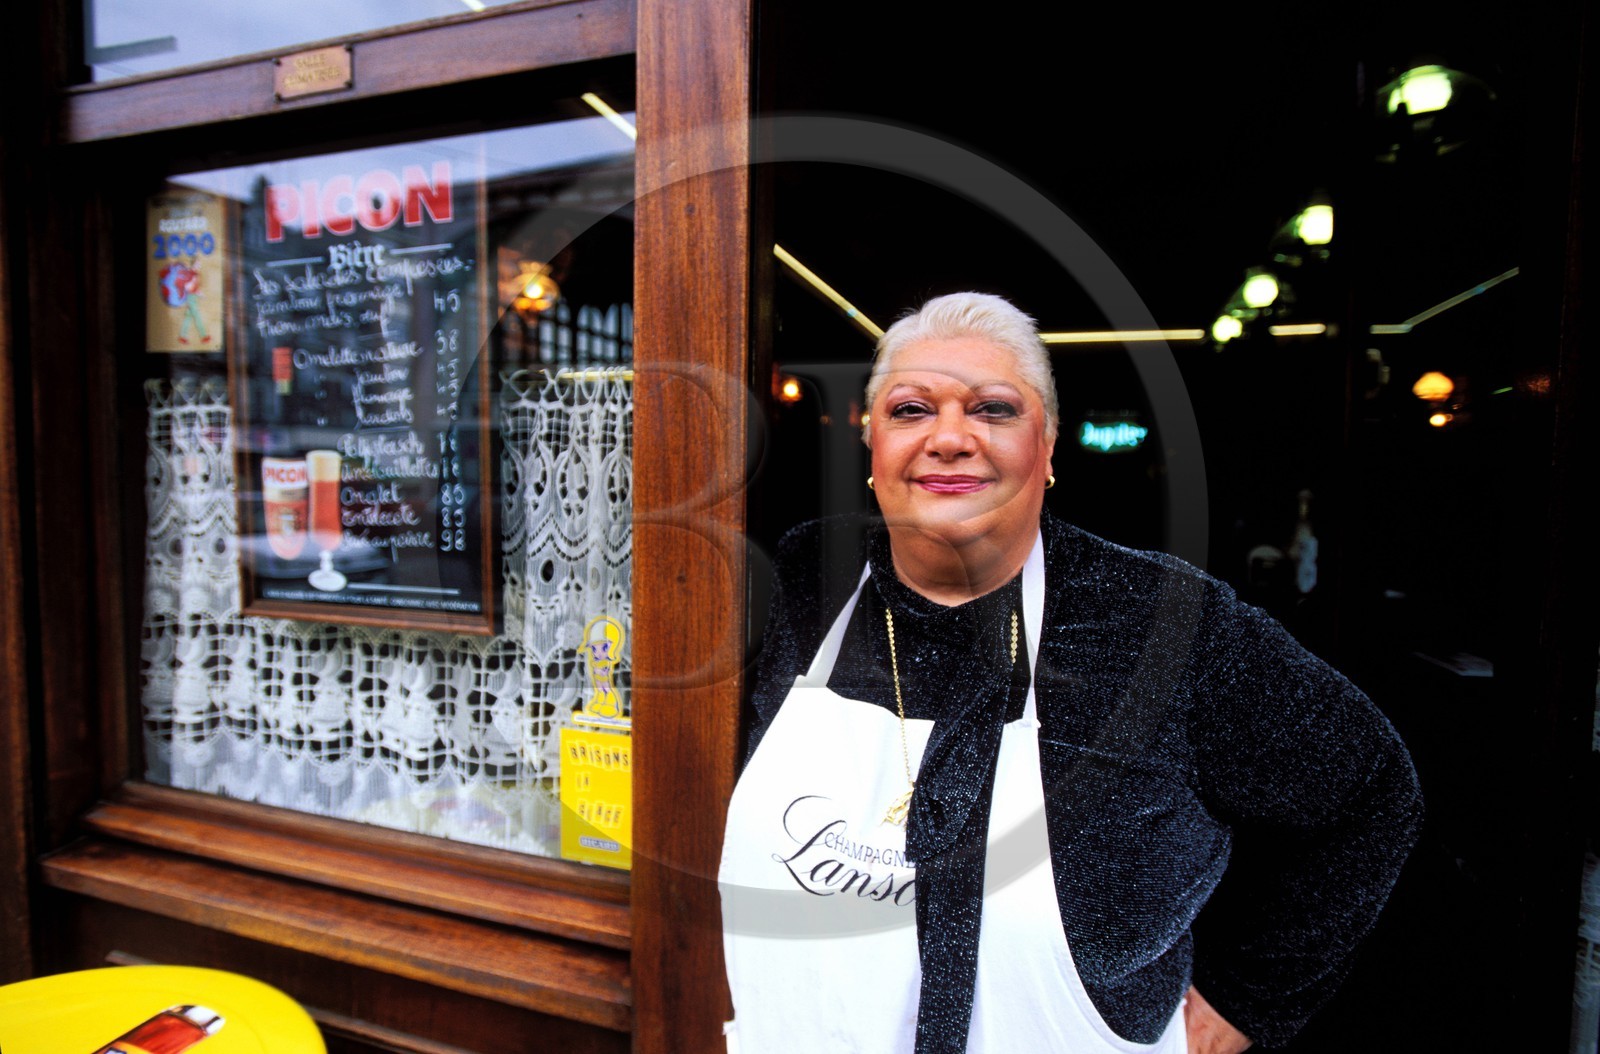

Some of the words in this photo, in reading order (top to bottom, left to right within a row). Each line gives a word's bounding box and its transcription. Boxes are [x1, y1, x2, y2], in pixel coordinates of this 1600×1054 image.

[265, 161, 454, 243] PICON
[153, 231, 215, 259] 2000
[440, 529, 466, 552] 98
[570, 747, 630, 767] BRISONS
